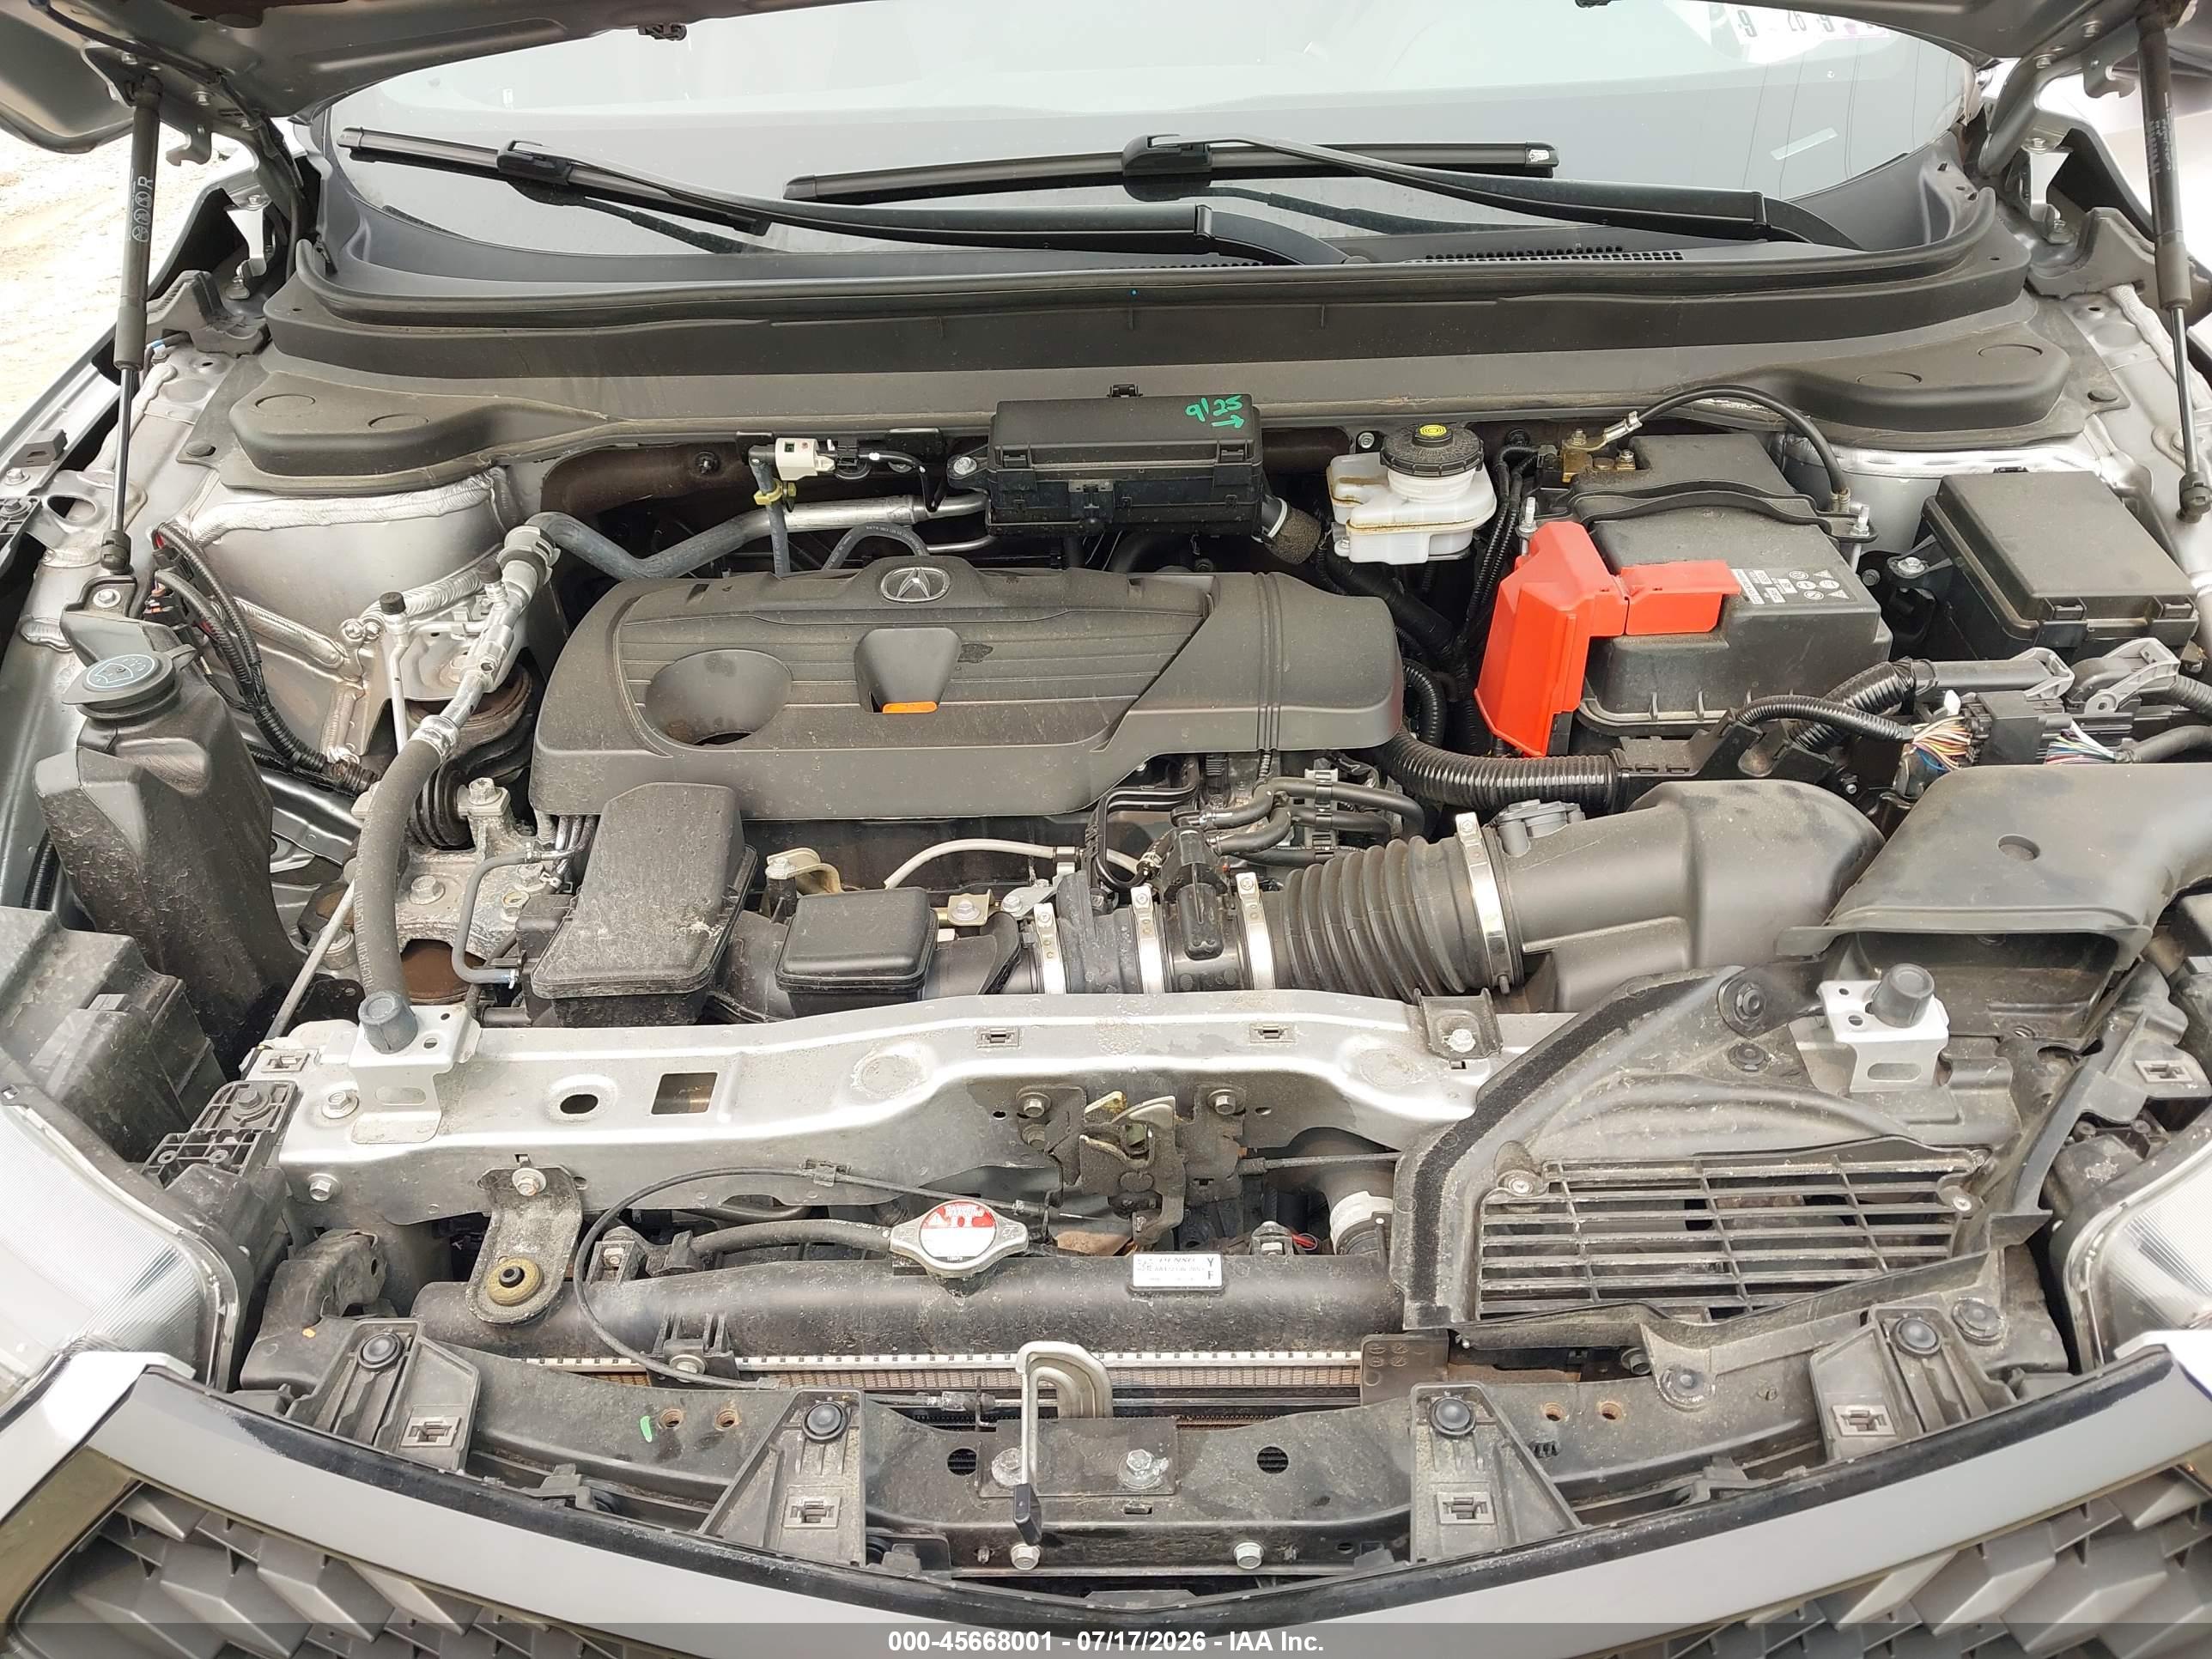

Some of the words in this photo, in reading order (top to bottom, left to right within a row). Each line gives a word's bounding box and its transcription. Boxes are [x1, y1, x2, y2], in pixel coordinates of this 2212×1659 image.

[137, 176, 154, 191] R
[358, 941, 375, 989] NICHIRIN
[1206, 1256, 1214, 1267] Y
